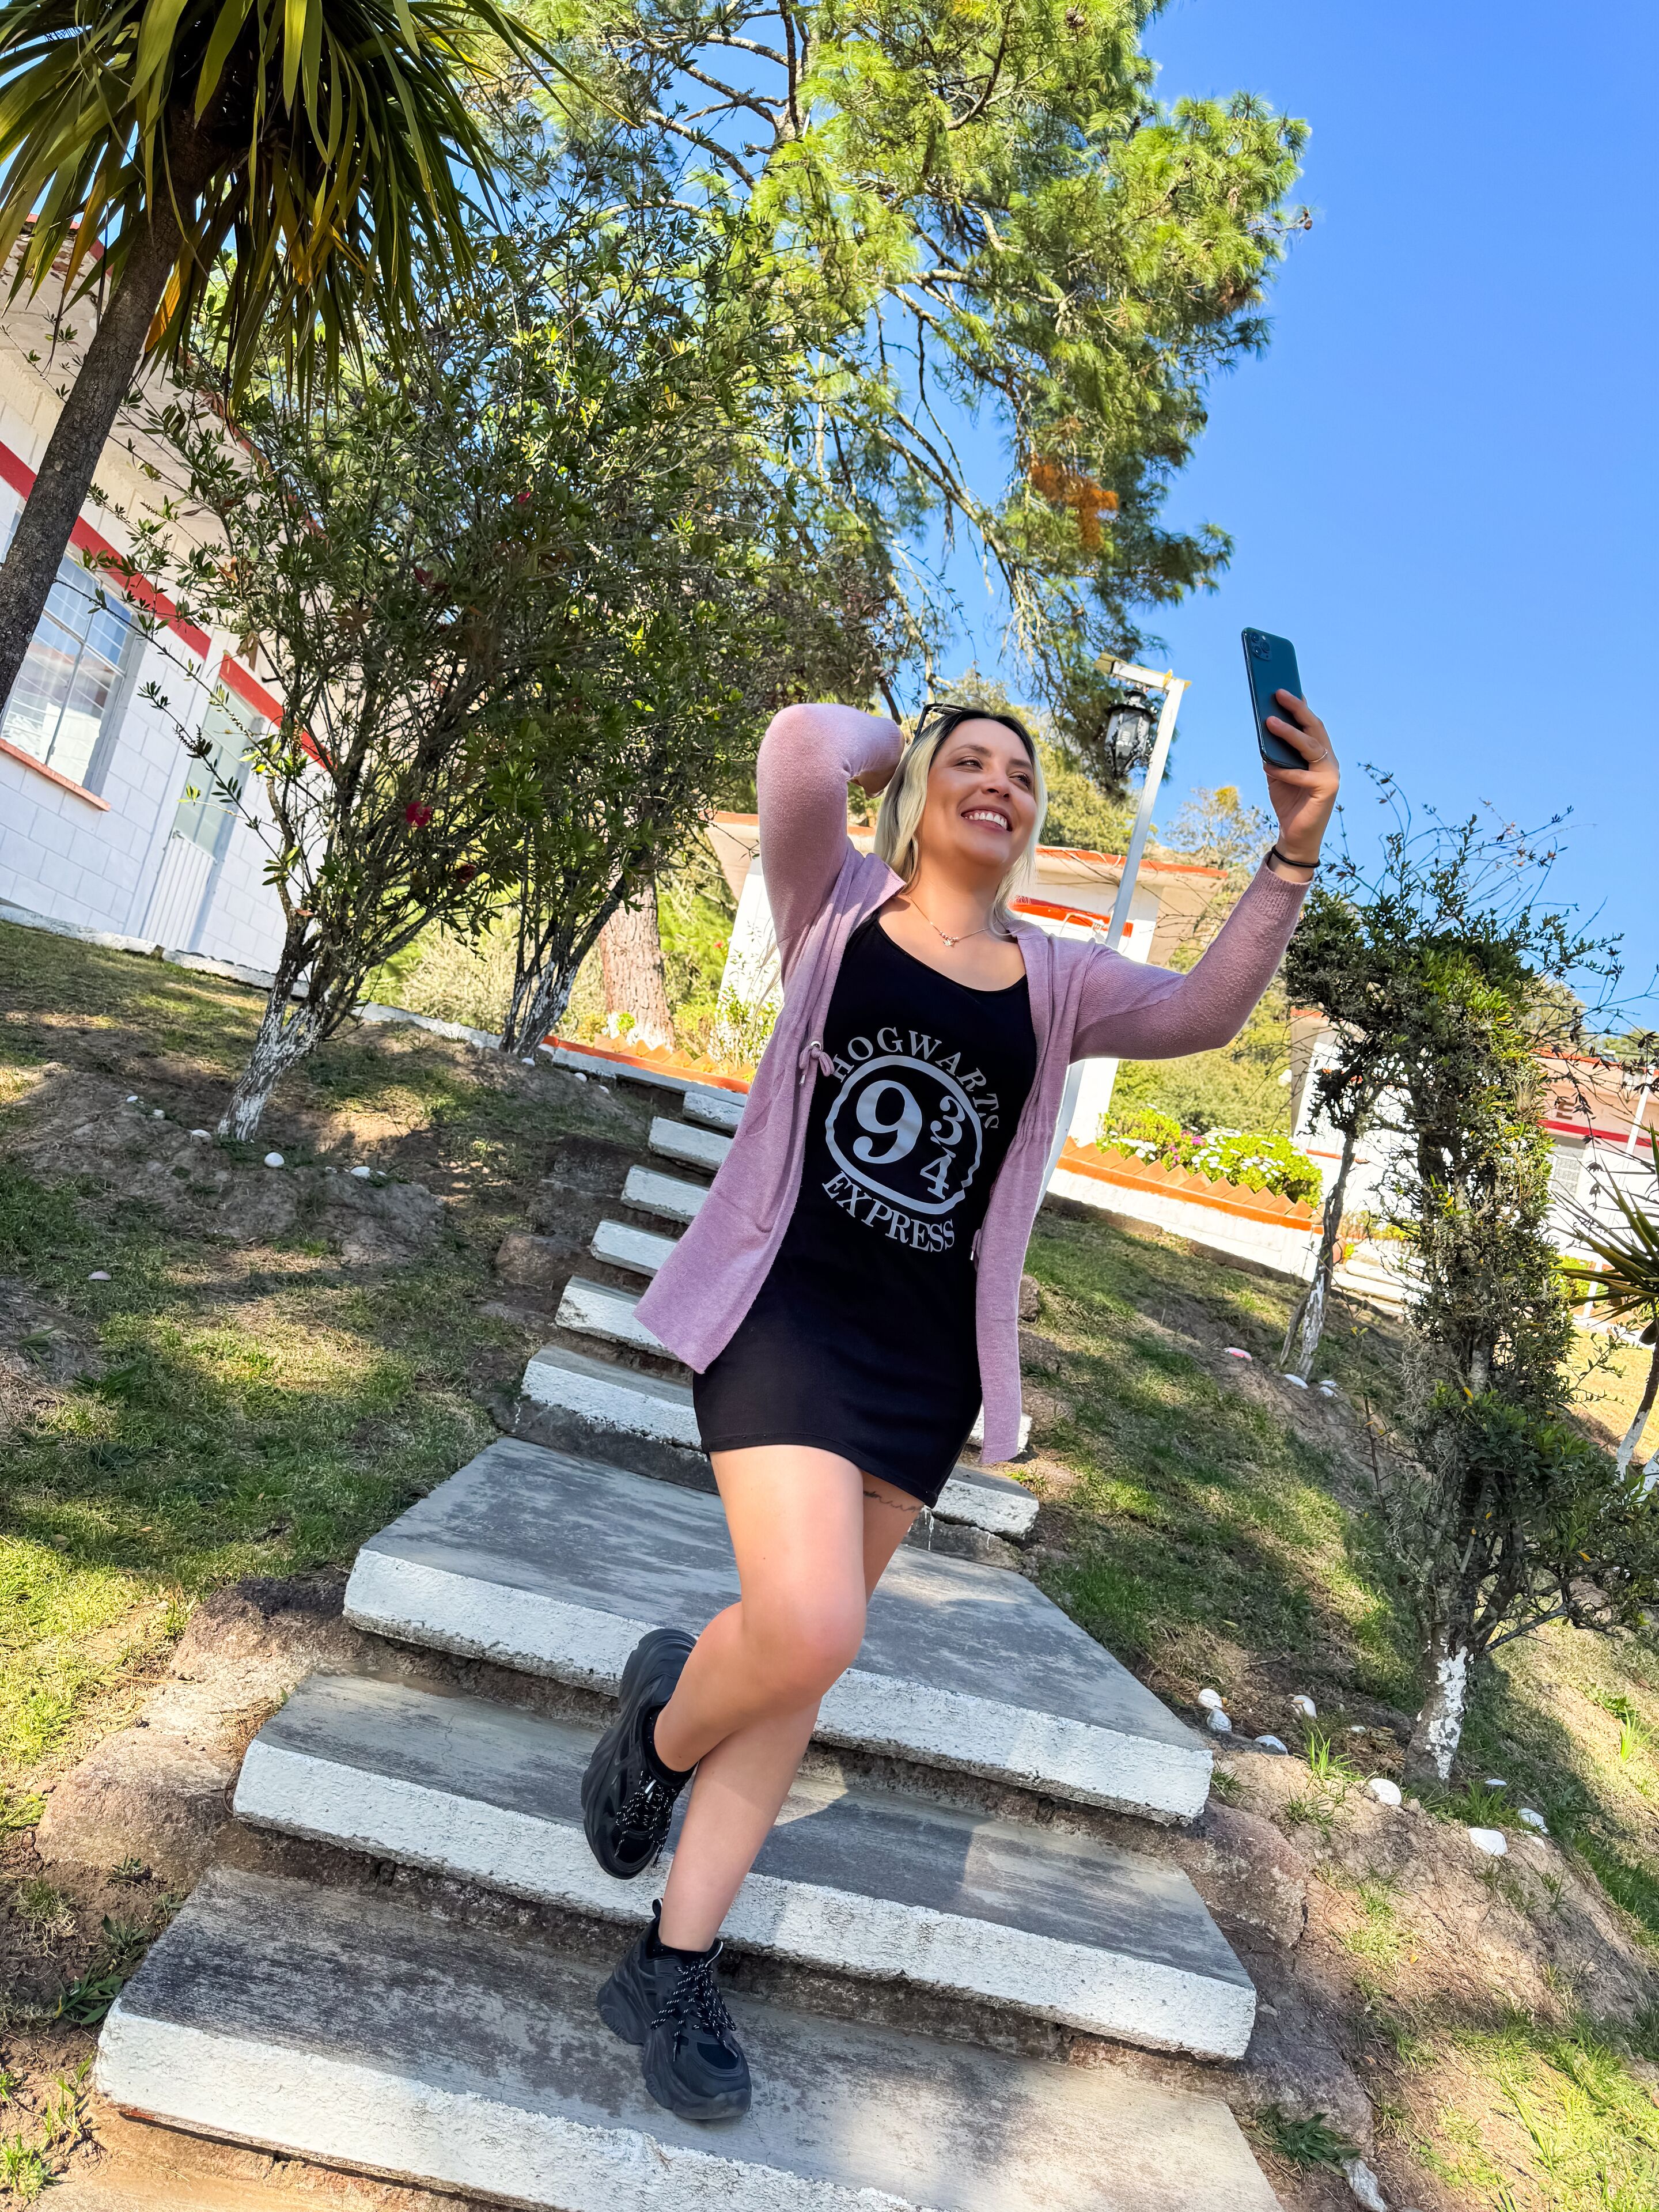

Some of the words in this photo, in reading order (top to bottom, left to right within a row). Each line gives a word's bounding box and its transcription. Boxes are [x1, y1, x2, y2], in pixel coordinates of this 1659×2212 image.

[832, 1027, 999, 1129] HOGWARTS
[853, 1080, 922, 1164] 9
[821, 1170, 955, 1252] EXPRESS
